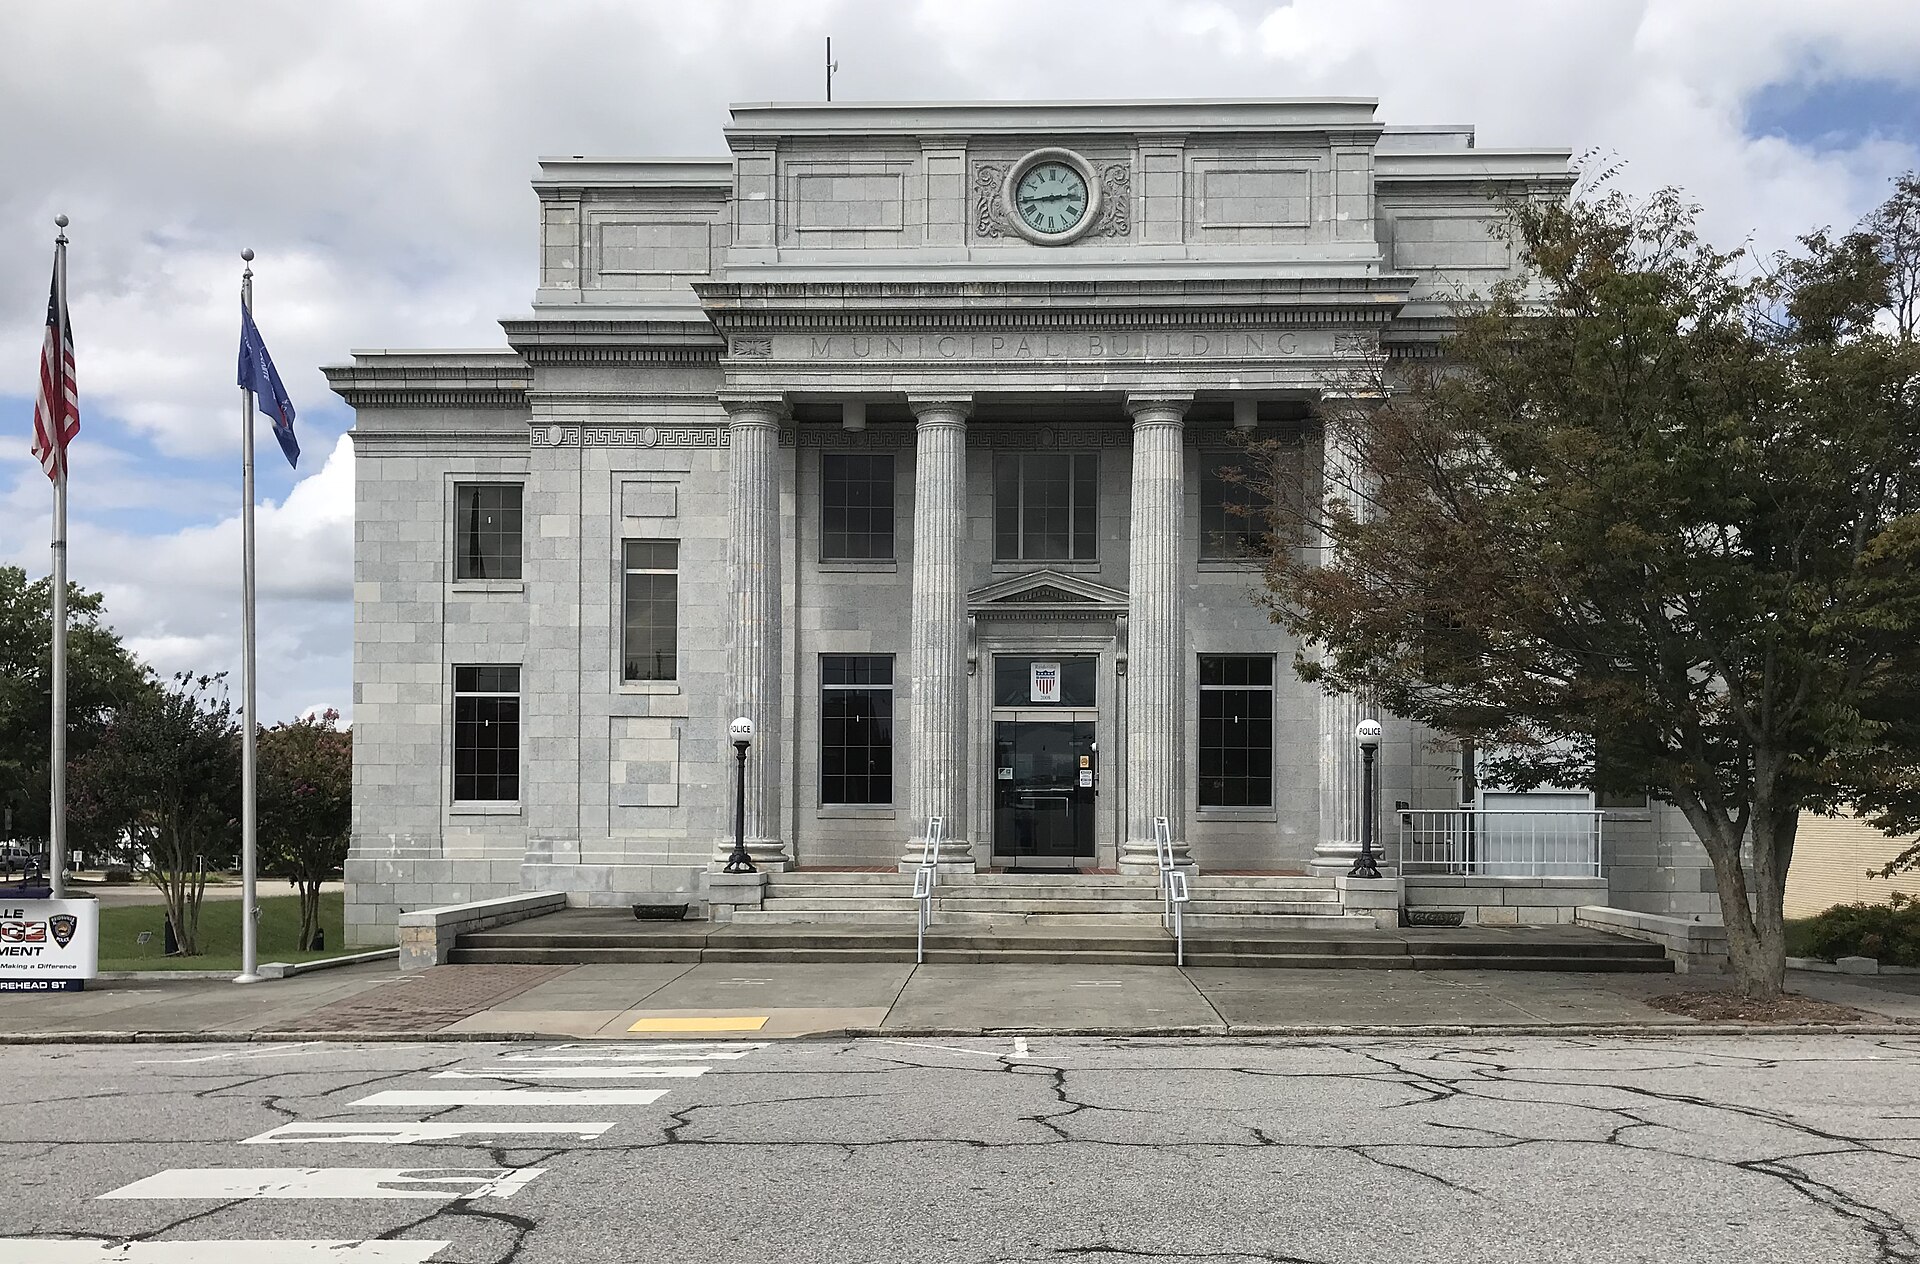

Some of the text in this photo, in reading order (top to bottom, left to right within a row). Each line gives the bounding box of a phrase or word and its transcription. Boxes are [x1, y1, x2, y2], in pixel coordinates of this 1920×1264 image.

[810, 332, 1298, 358] MUNICIPAL BUILDING
[1359, 727, 1381, 736] POLICE
[0, 909, 24, 919] LE
[0, 946, 44, 956] MENT
[0, 981, 67, 990] REHEAD ST
